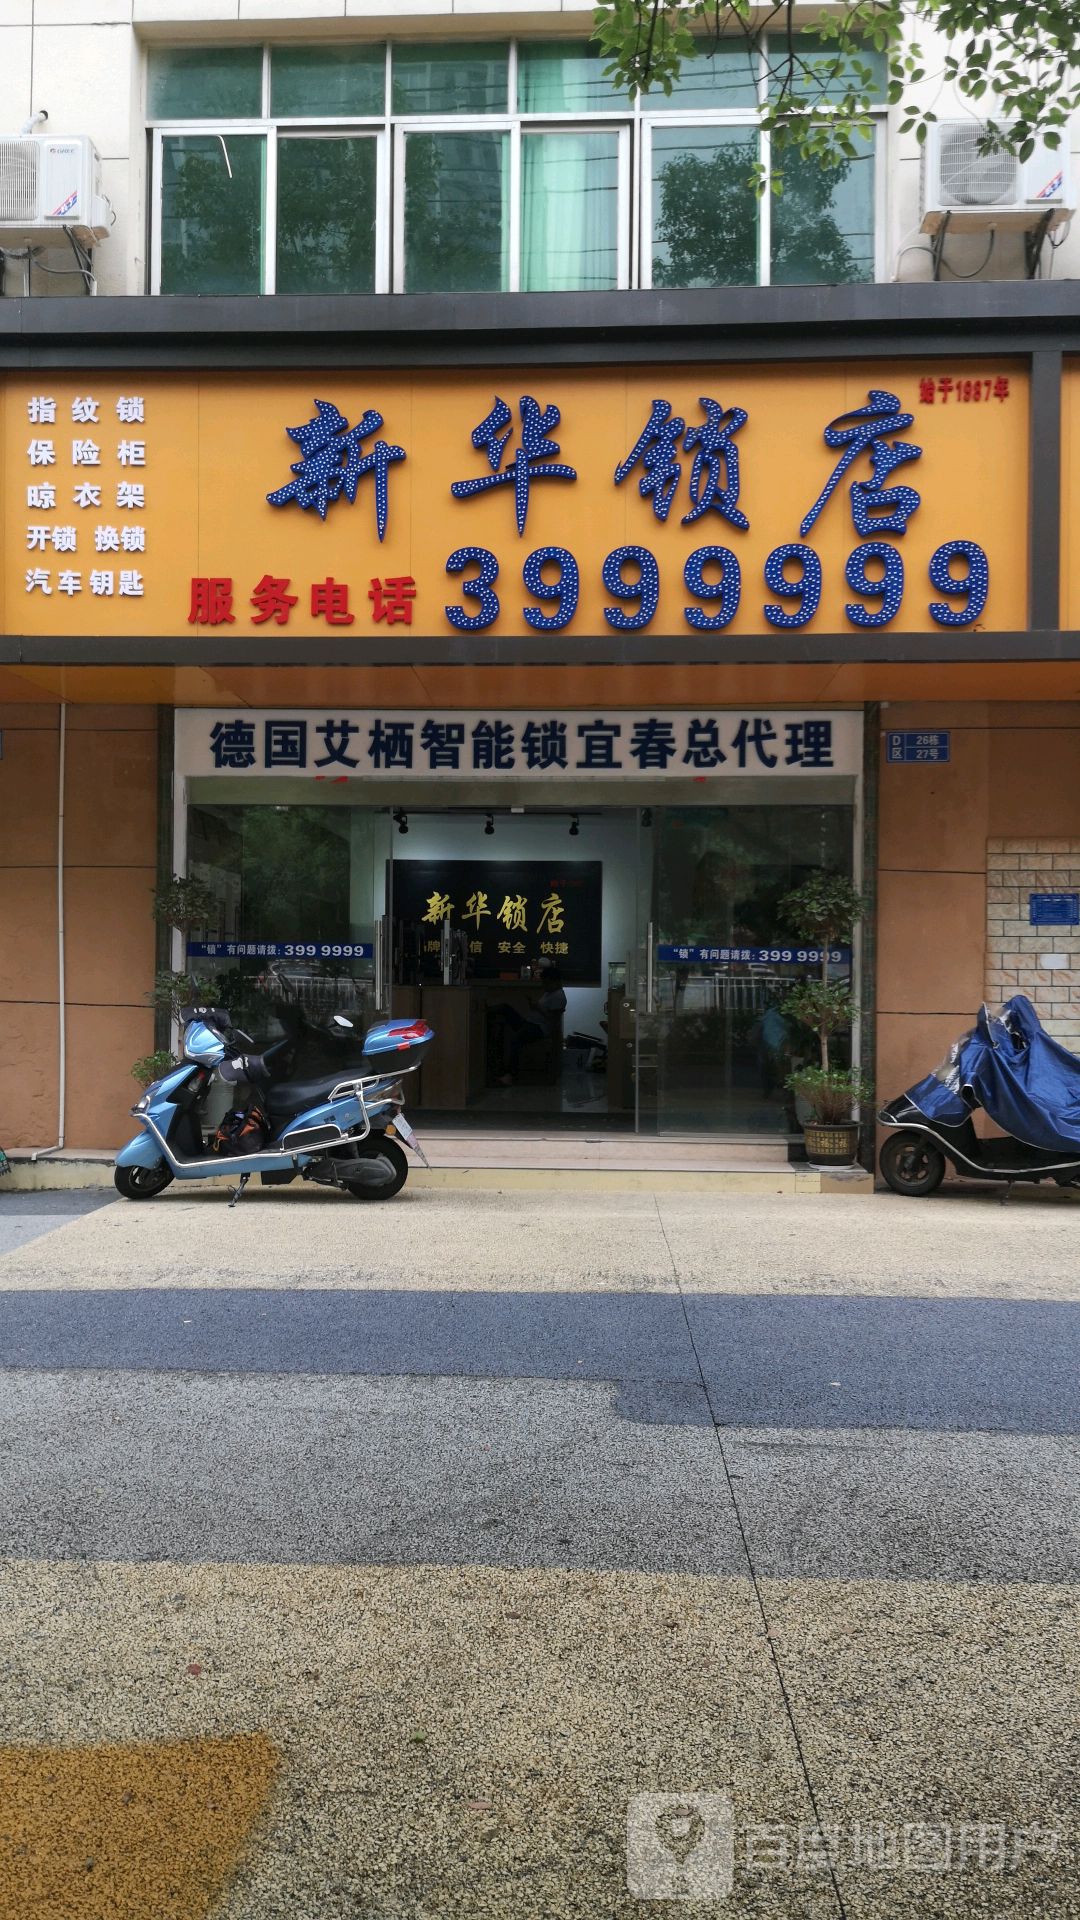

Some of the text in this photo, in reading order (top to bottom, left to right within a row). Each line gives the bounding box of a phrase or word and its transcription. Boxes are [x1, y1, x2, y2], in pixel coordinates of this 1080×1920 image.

[28, 396, 145, 424] 指纹锁
[27, 439, 146, 466] 保险柜
[266, 389, 923, 543] 新华锁店
[27, 481, 146, 509] 晾衣架
[26, 525, 146, 552] 开锁 换锁
[25, 569, 144, 596] 汽车钥匙
[188, 540, 989, 631] 服务电话 3999999
[210, 719, 834, 769] 德国艾栖智能锁宜春总代理
[916, 748, 940, 760] 27号
[421, 891, 566, 934] 新华锁店
[498, 941, 526, 954] 安全
[540, 941, 569, 955] 快捷
